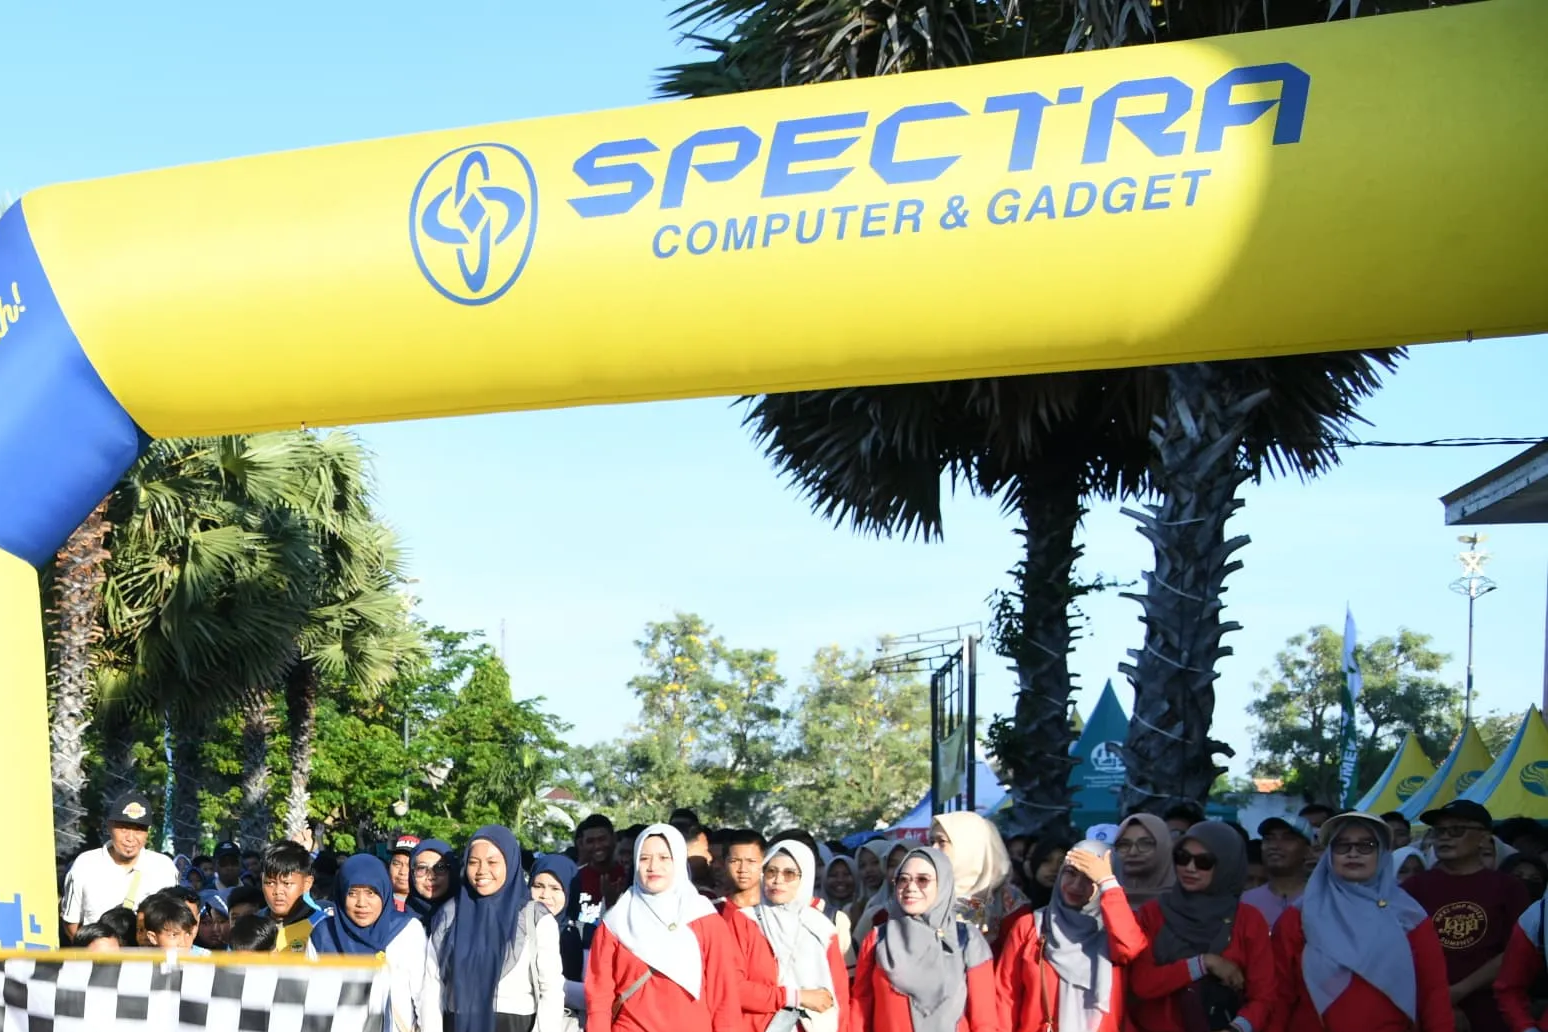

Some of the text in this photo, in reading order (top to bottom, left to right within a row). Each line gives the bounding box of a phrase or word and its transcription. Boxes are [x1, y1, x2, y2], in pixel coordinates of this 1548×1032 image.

[566, 61, 1311, 220] SPECTRA
[651, 168, 1212, 260] COMPUTER & GADGET
